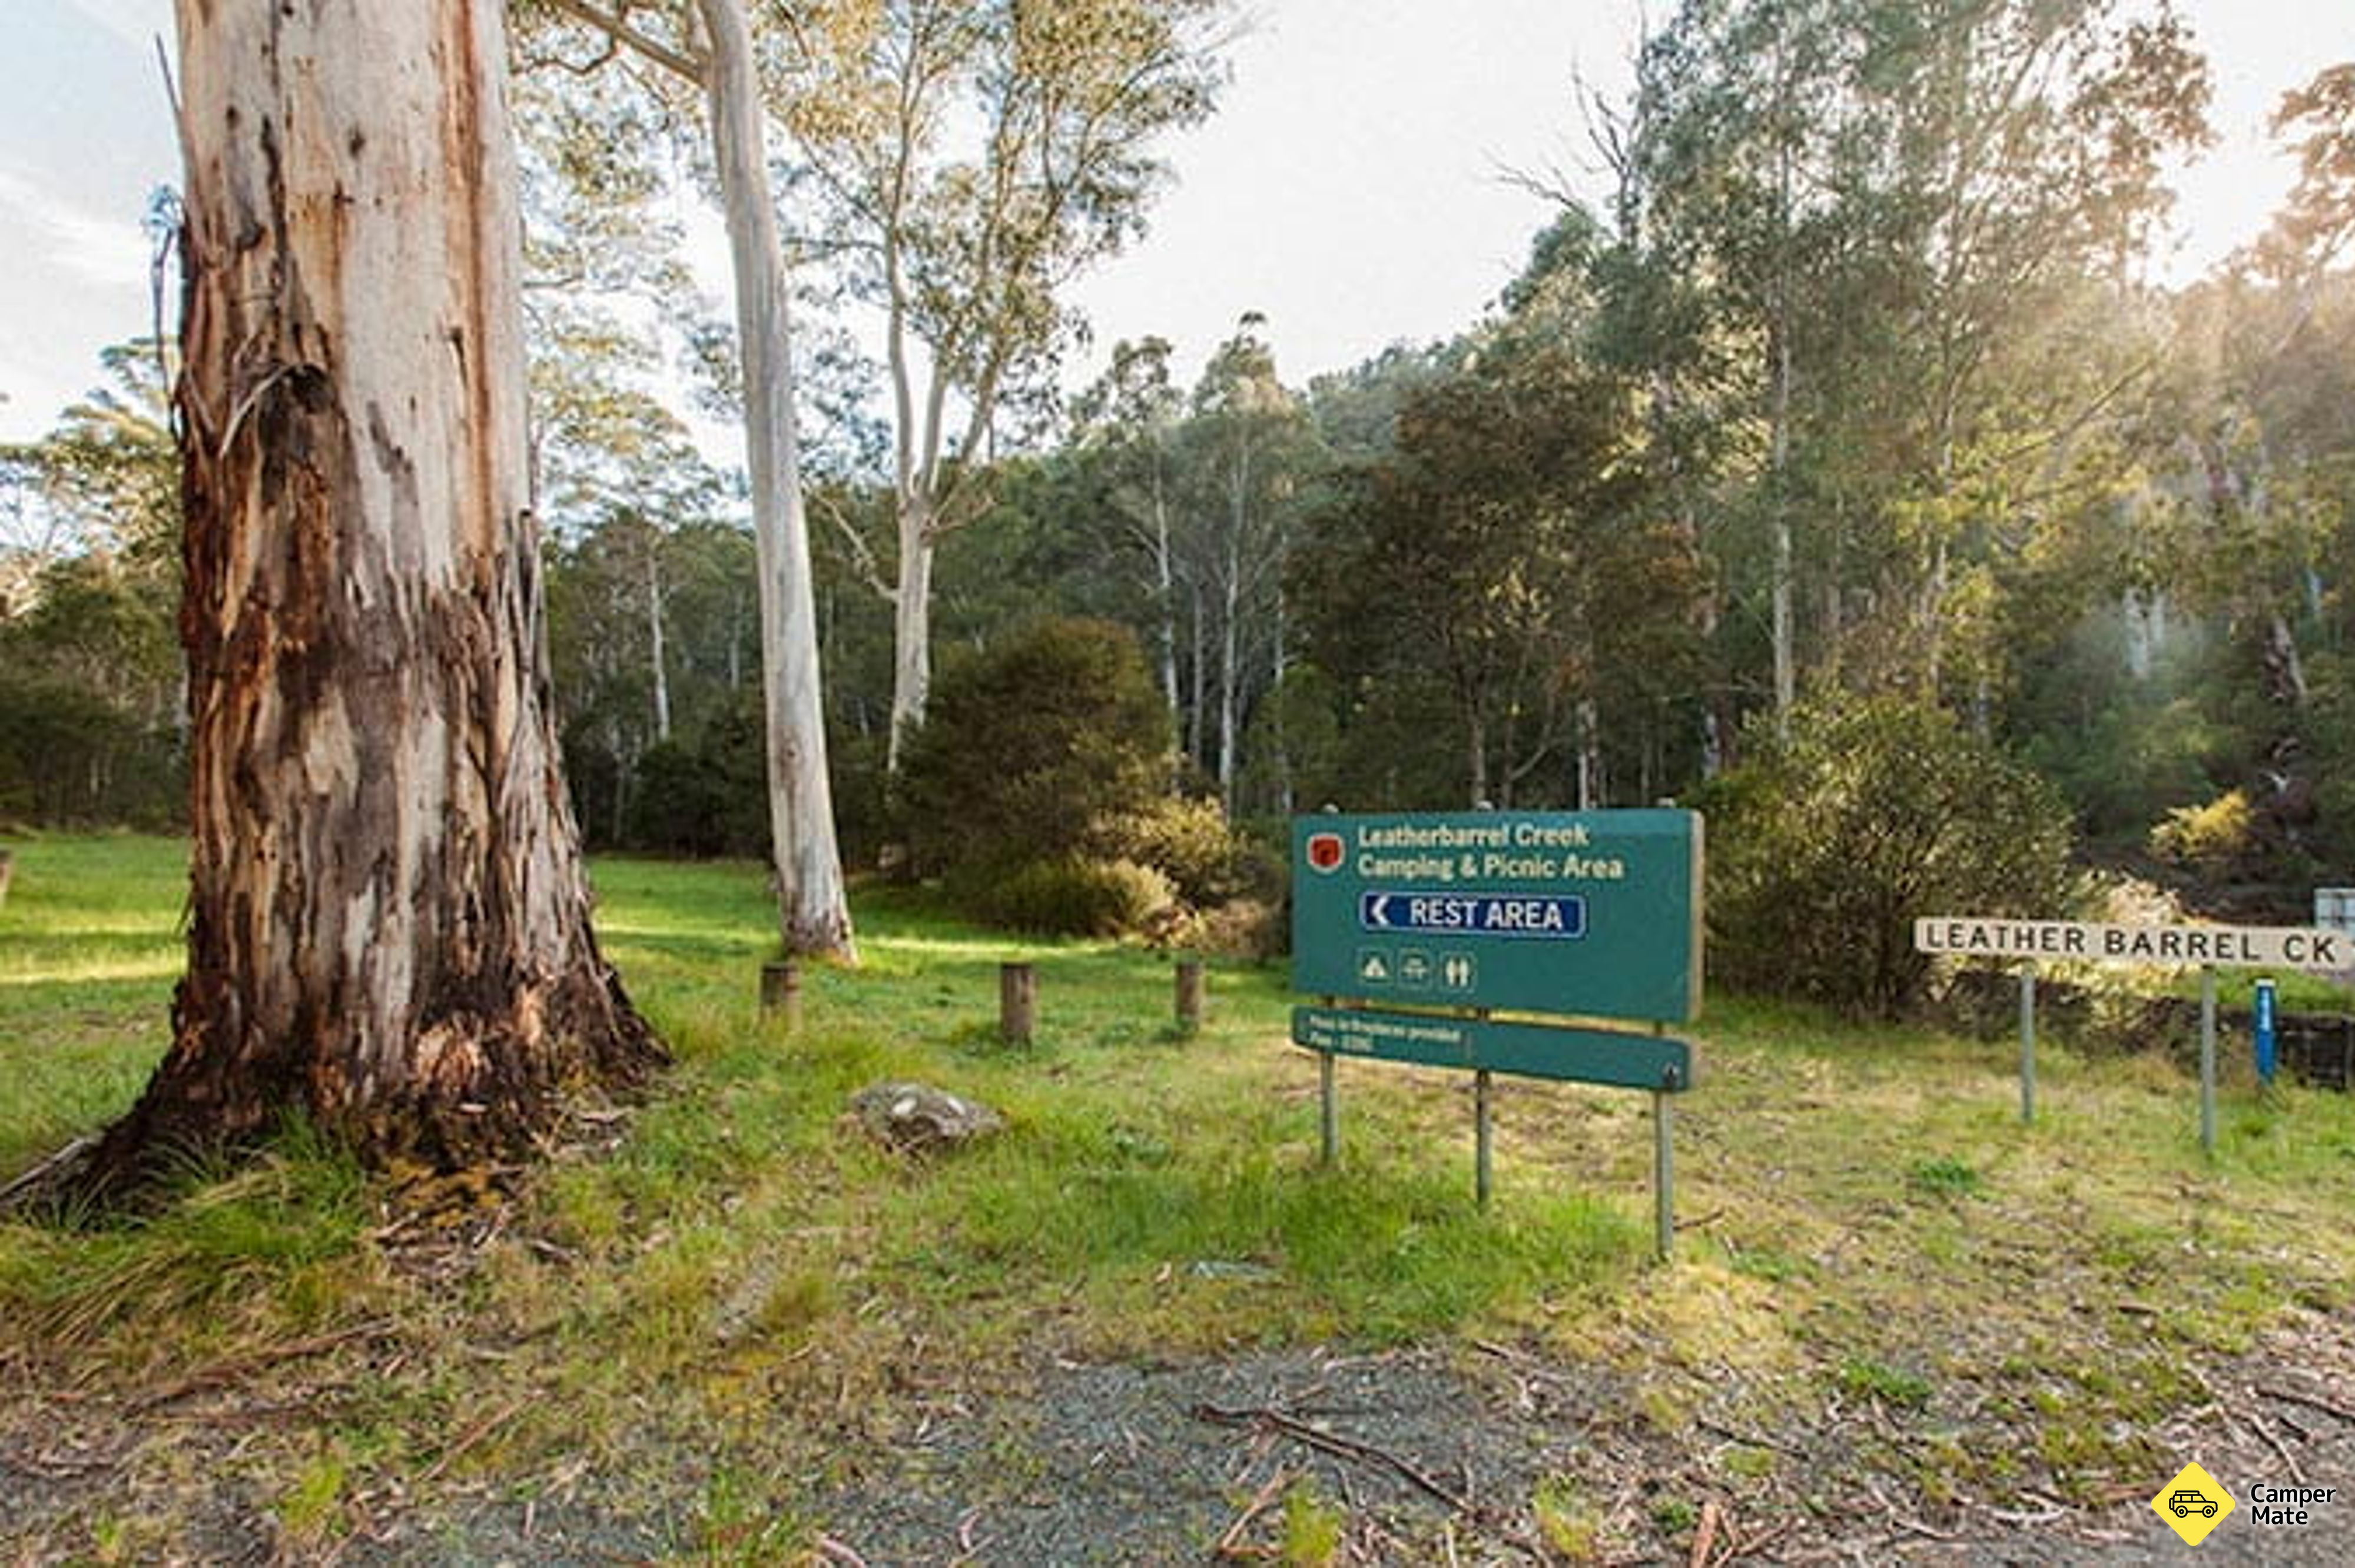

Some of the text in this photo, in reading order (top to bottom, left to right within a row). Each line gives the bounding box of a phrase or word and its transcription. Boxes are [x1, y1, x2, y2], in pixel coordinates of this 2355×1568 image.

[1358, 823, 1589, 848] Leatherbarrel Creek
[1358, 853, 1624, 880] Camping & Picnic Area
[1410, 899, 1563, 930] REST AREA
[1926, 923, 2336, 964] LEATHER BARREL CK
